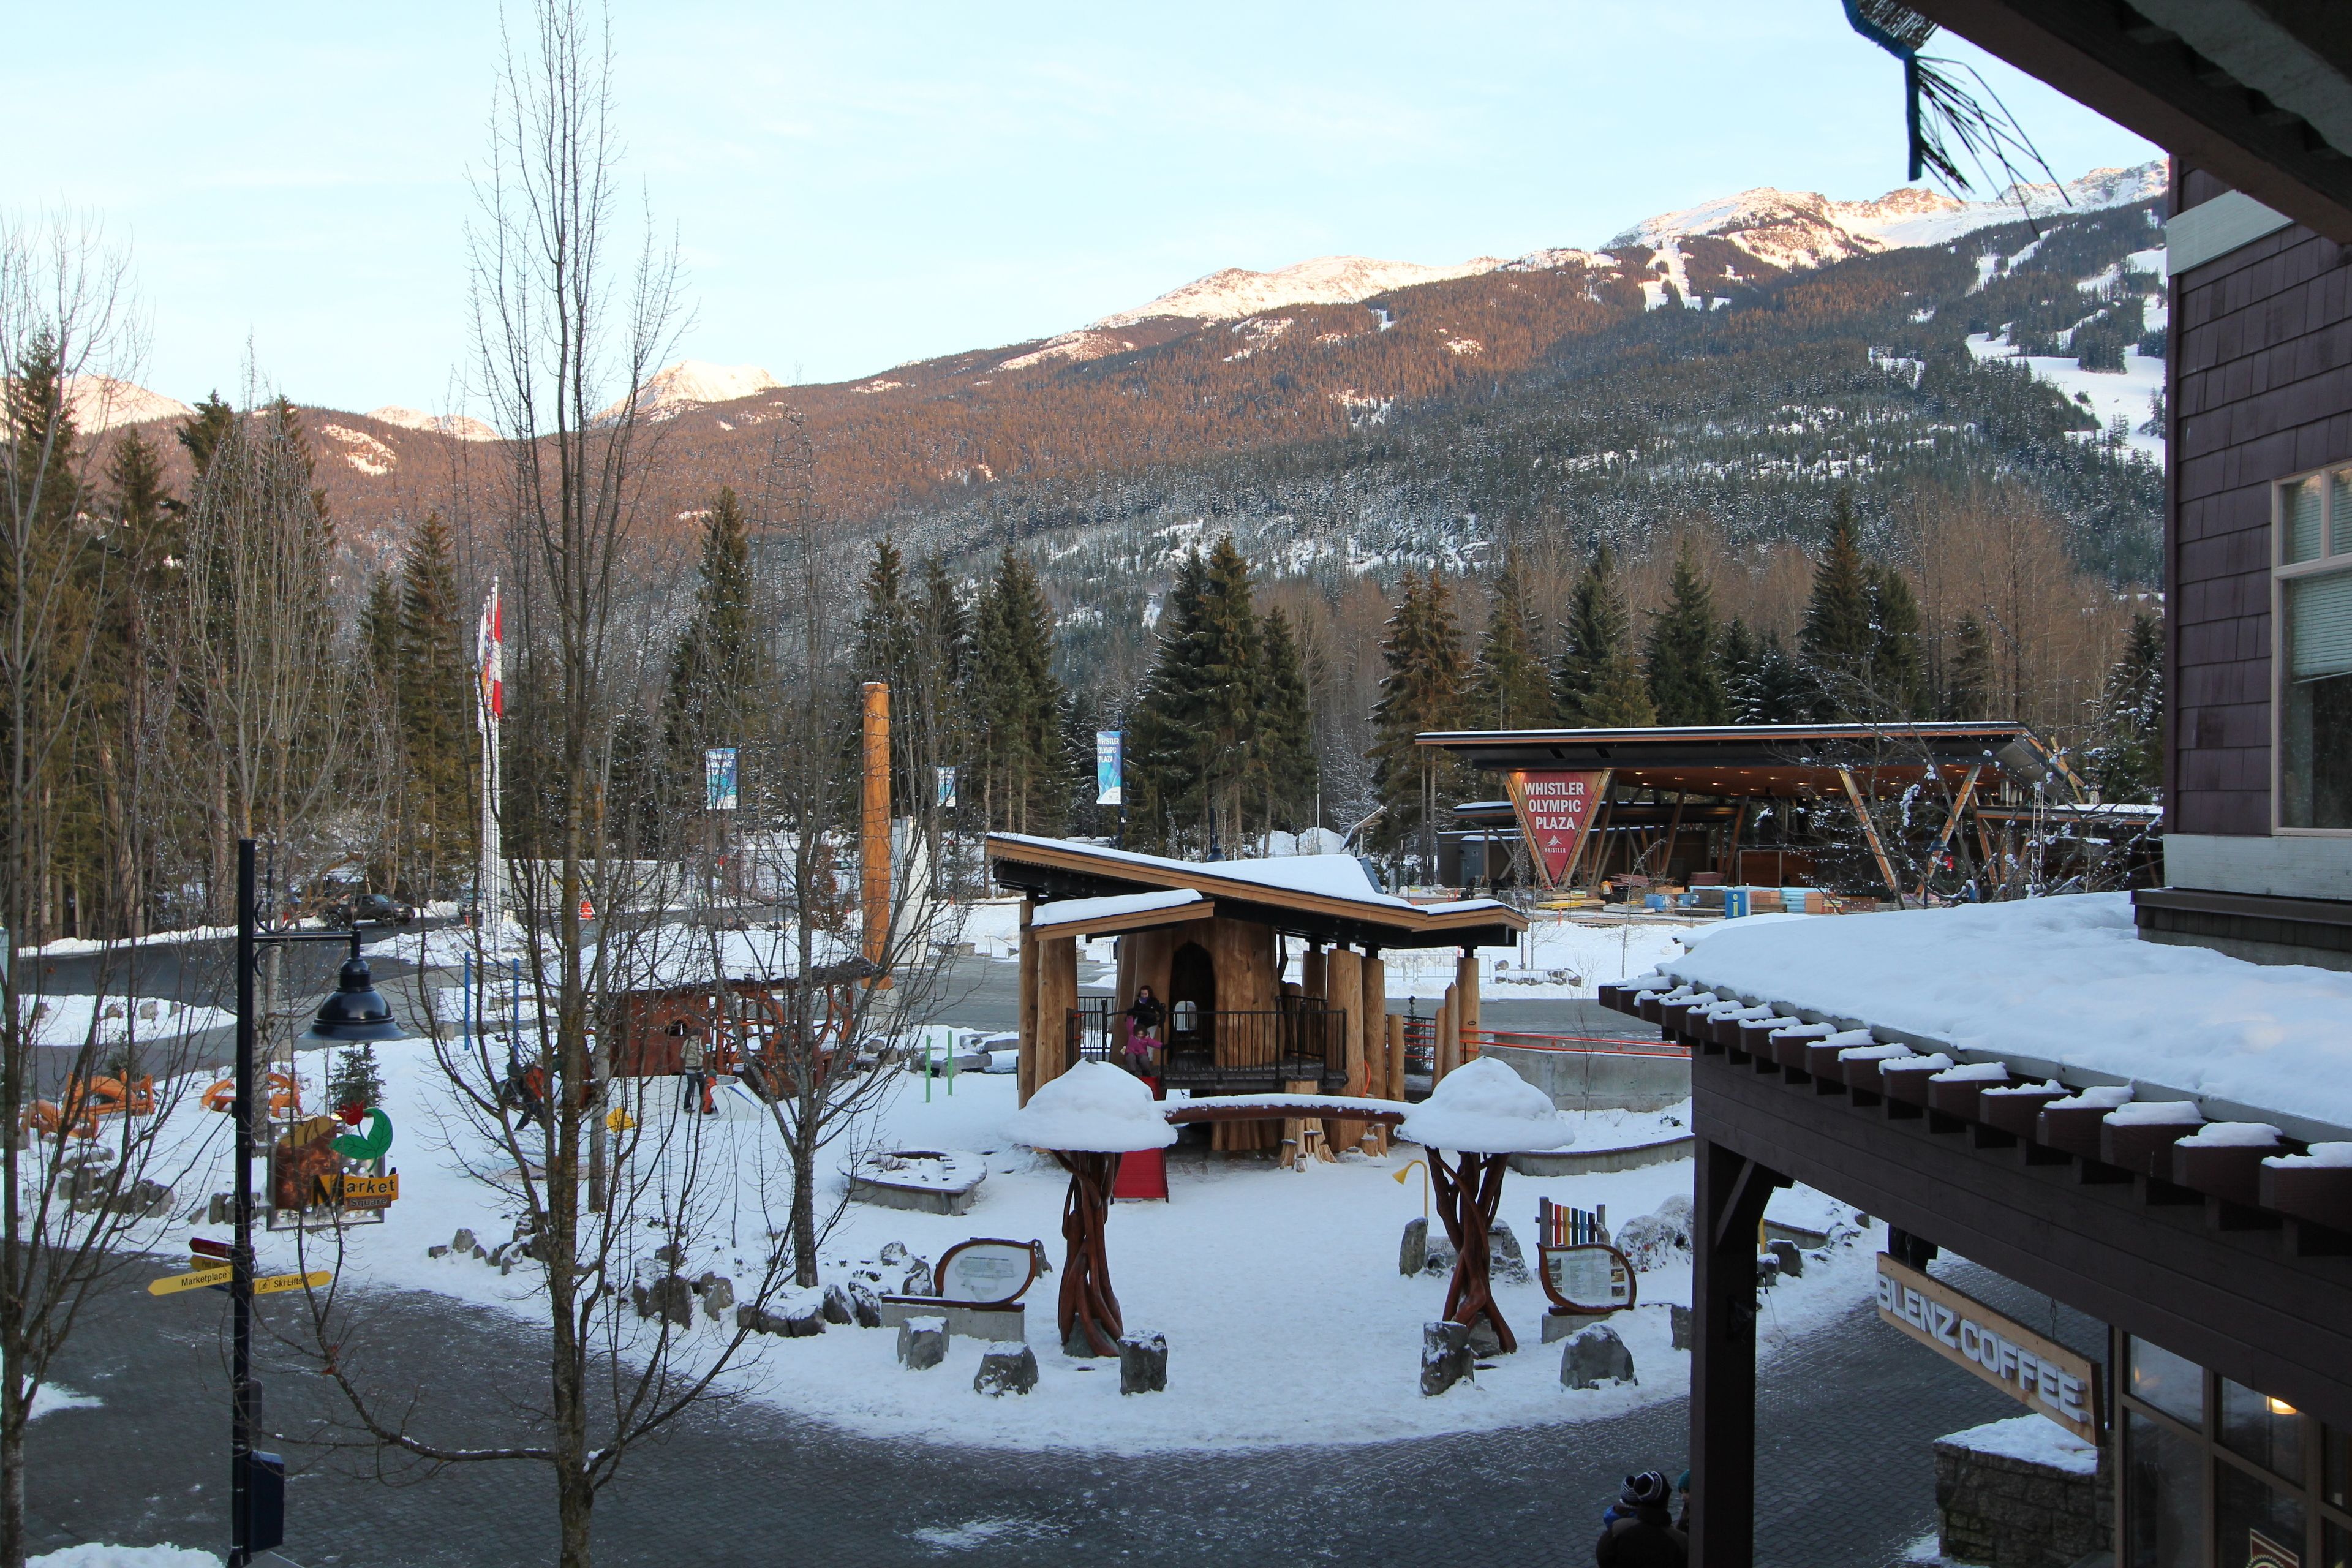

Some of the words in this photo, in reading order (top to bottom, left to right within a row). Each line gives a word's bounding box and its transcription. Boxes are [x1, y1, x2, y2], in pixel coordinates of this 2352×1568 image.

[1523, 782, 1585, 795] WHISTLER
[1528, 799, 1581, 813] OLYMPIC
[1536, 816, 1575, 830] PLAZA
[312, 1168, 396, 1207] Market
[350, 1198, 387, 1208] Square
[181, 1271, 227, 1287] Marketplace
[274, 1278, 285, 1288] Ski
[287, 1276, 303, 1286] Lifts
[1877, 1272, 1961, 1349] BLENZ
[1961, 1319, 2087, 1422] COFFEE
